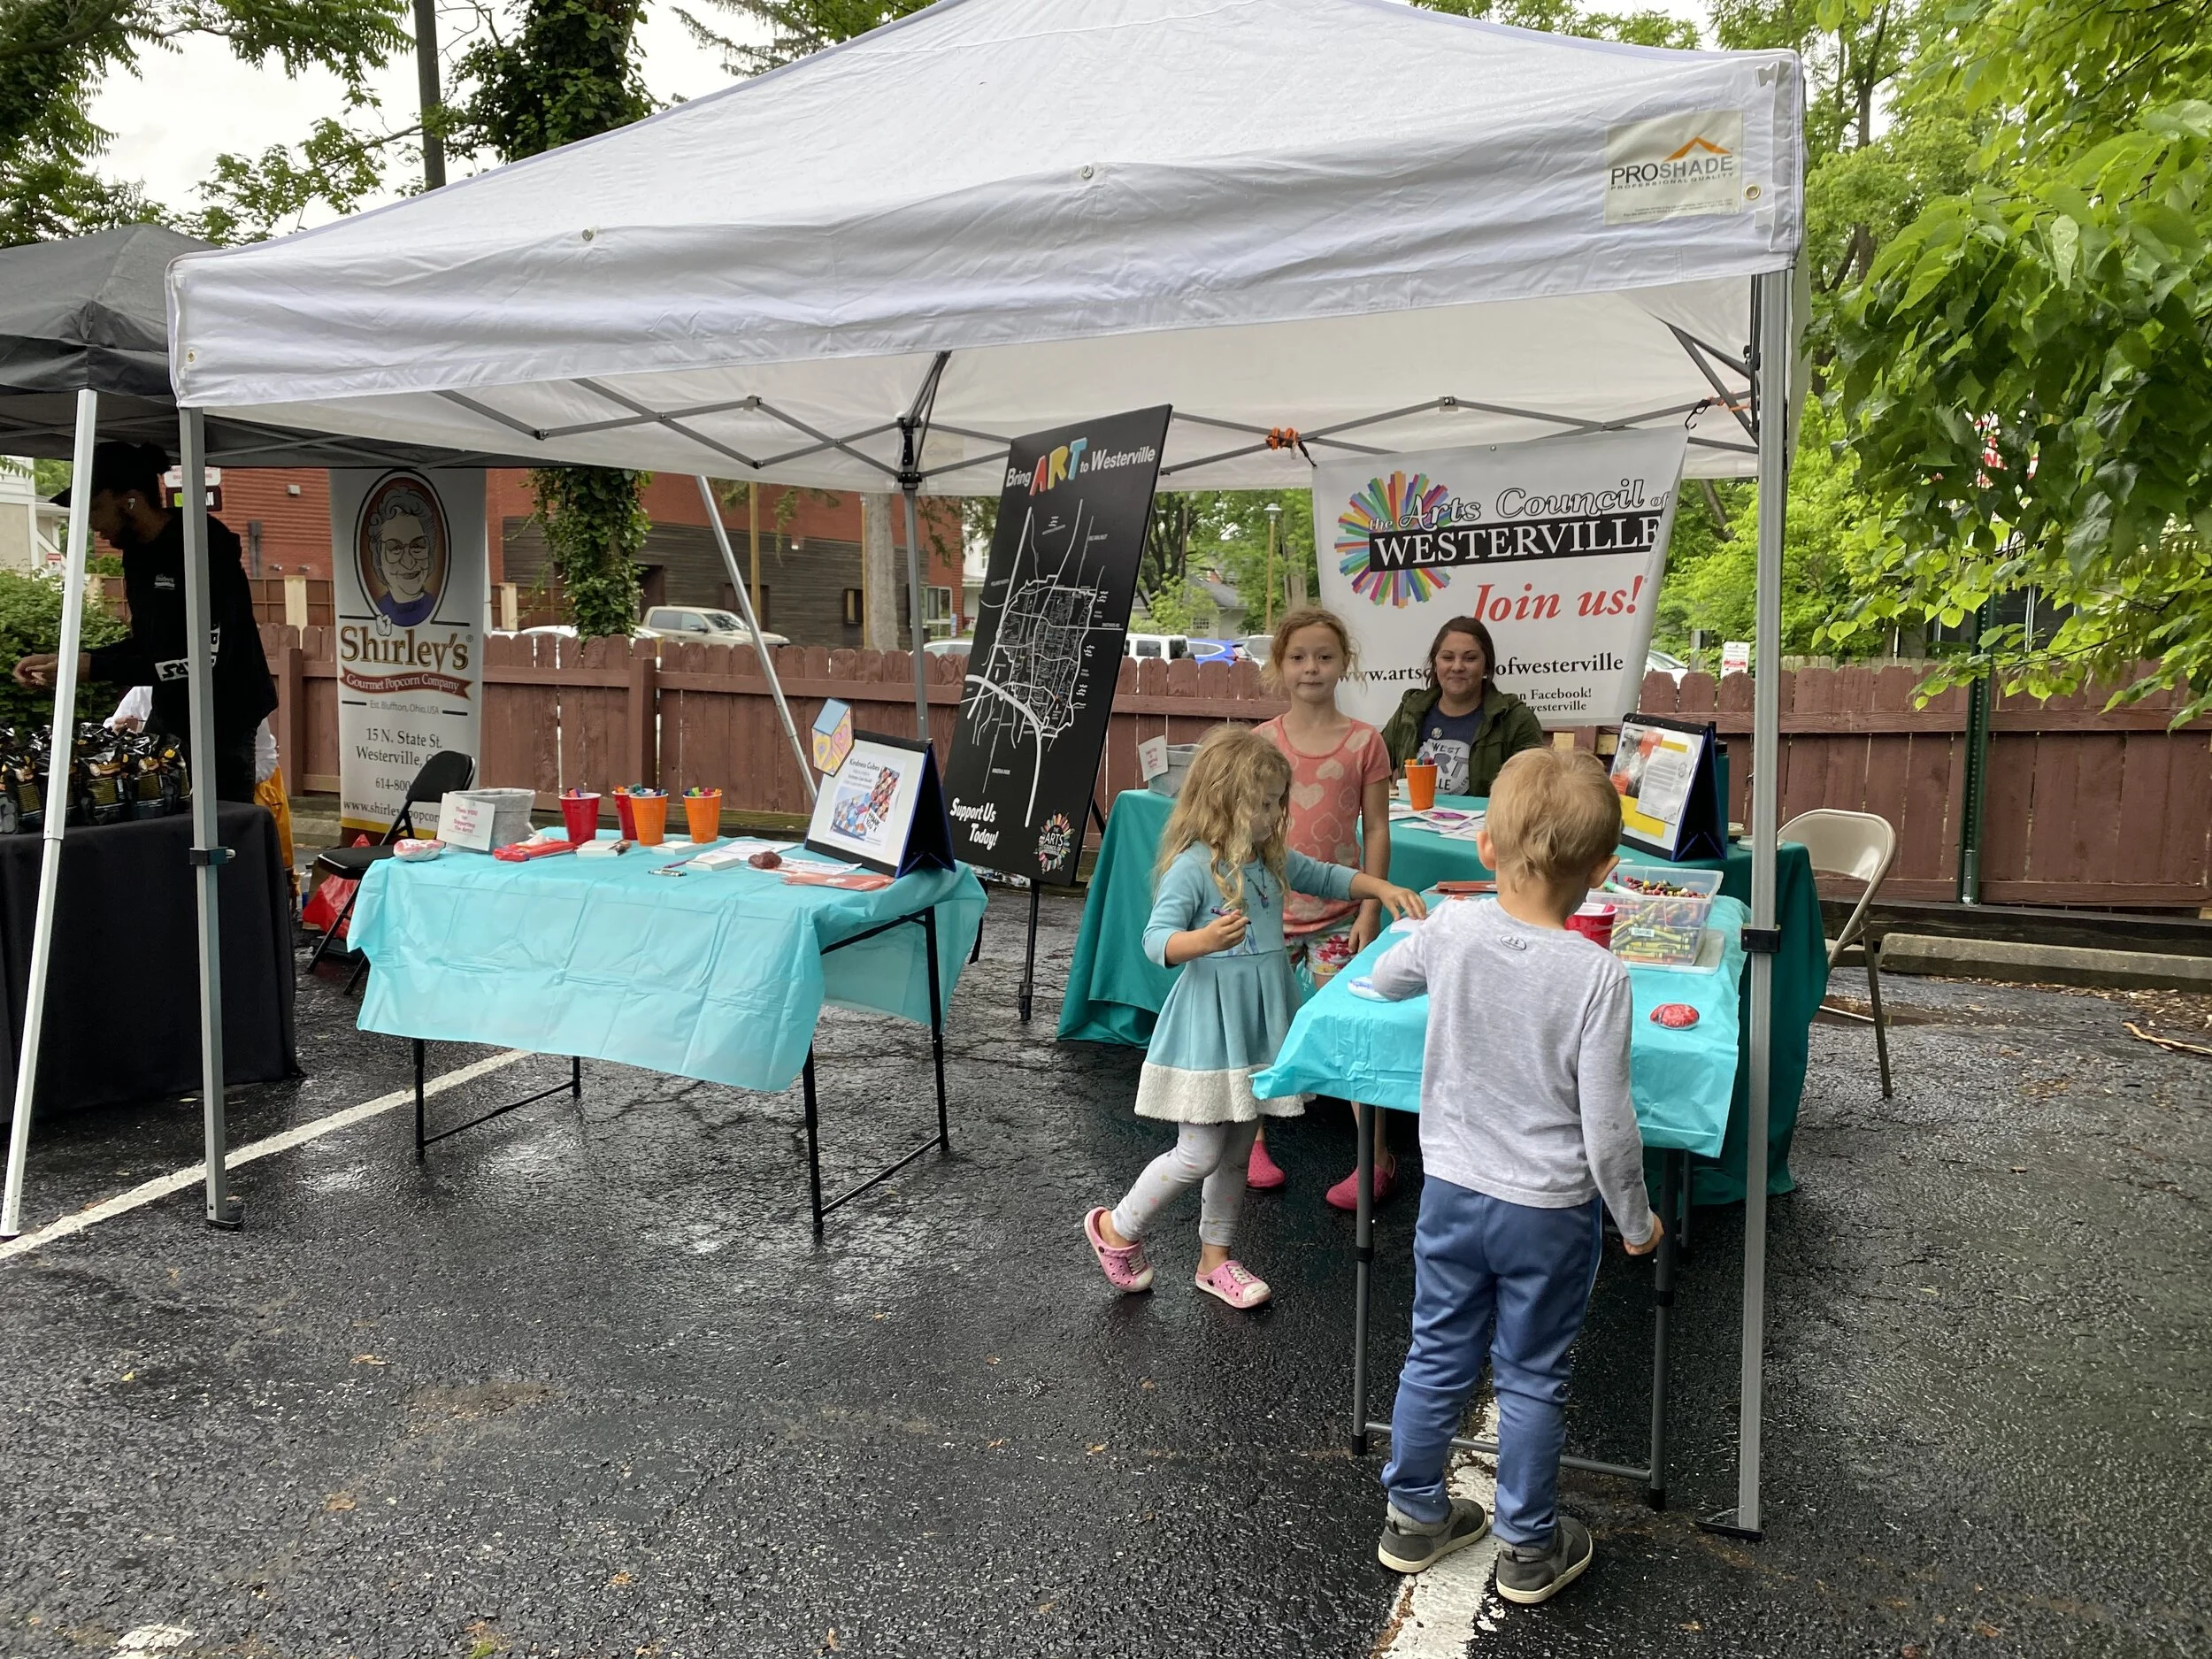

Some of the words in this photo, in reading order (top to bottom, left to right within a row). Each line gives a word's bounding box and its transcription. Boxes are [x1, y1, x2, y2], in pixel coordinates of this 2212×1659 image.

[1610, 156, 1733, 185] PROSHADE
[1610, 178, 1687, 190] PROFESSIONAL
[1691, 172, 1734, 182] QUALITY
[1006, 467, 1032, 488] Bring
[1029, 437, 1087, 496] ART
[1079, 461, 1089, 473] to
[1091, 446, 1156, 472] Westerville
[1369, 518, 1394, 531] the
[1399, 495, 1481, 532] Arts
[1496, 479, 1645, 518] Council
[1374, 515, 1661, 567] WESTERVILLE
[1474, 583, 1561, 622] Join
[1578, 575, 1644, 617] us!
[341, 626, 469, 672] Shirley's
[346, 673, 384, 690] Gourmet
[385, 675, 420, 691] Popcorn
[421, 673, 459, 694] Company
[1531, 687, 1592, 701] Facebook!
[366, 727, 378, 741] 15
[381, 728, 394, 743] N.
[397, 730, 426, 747] State
[429, 733, 442, 749] St.
[356, 746, 423, 768] Westerville,
[949, 797, 984, 822] Support
[982, 802, 996, 822] Us
[970, 823, 999, 850] Today!
[1044, 832, 1064, 847] ARTS
